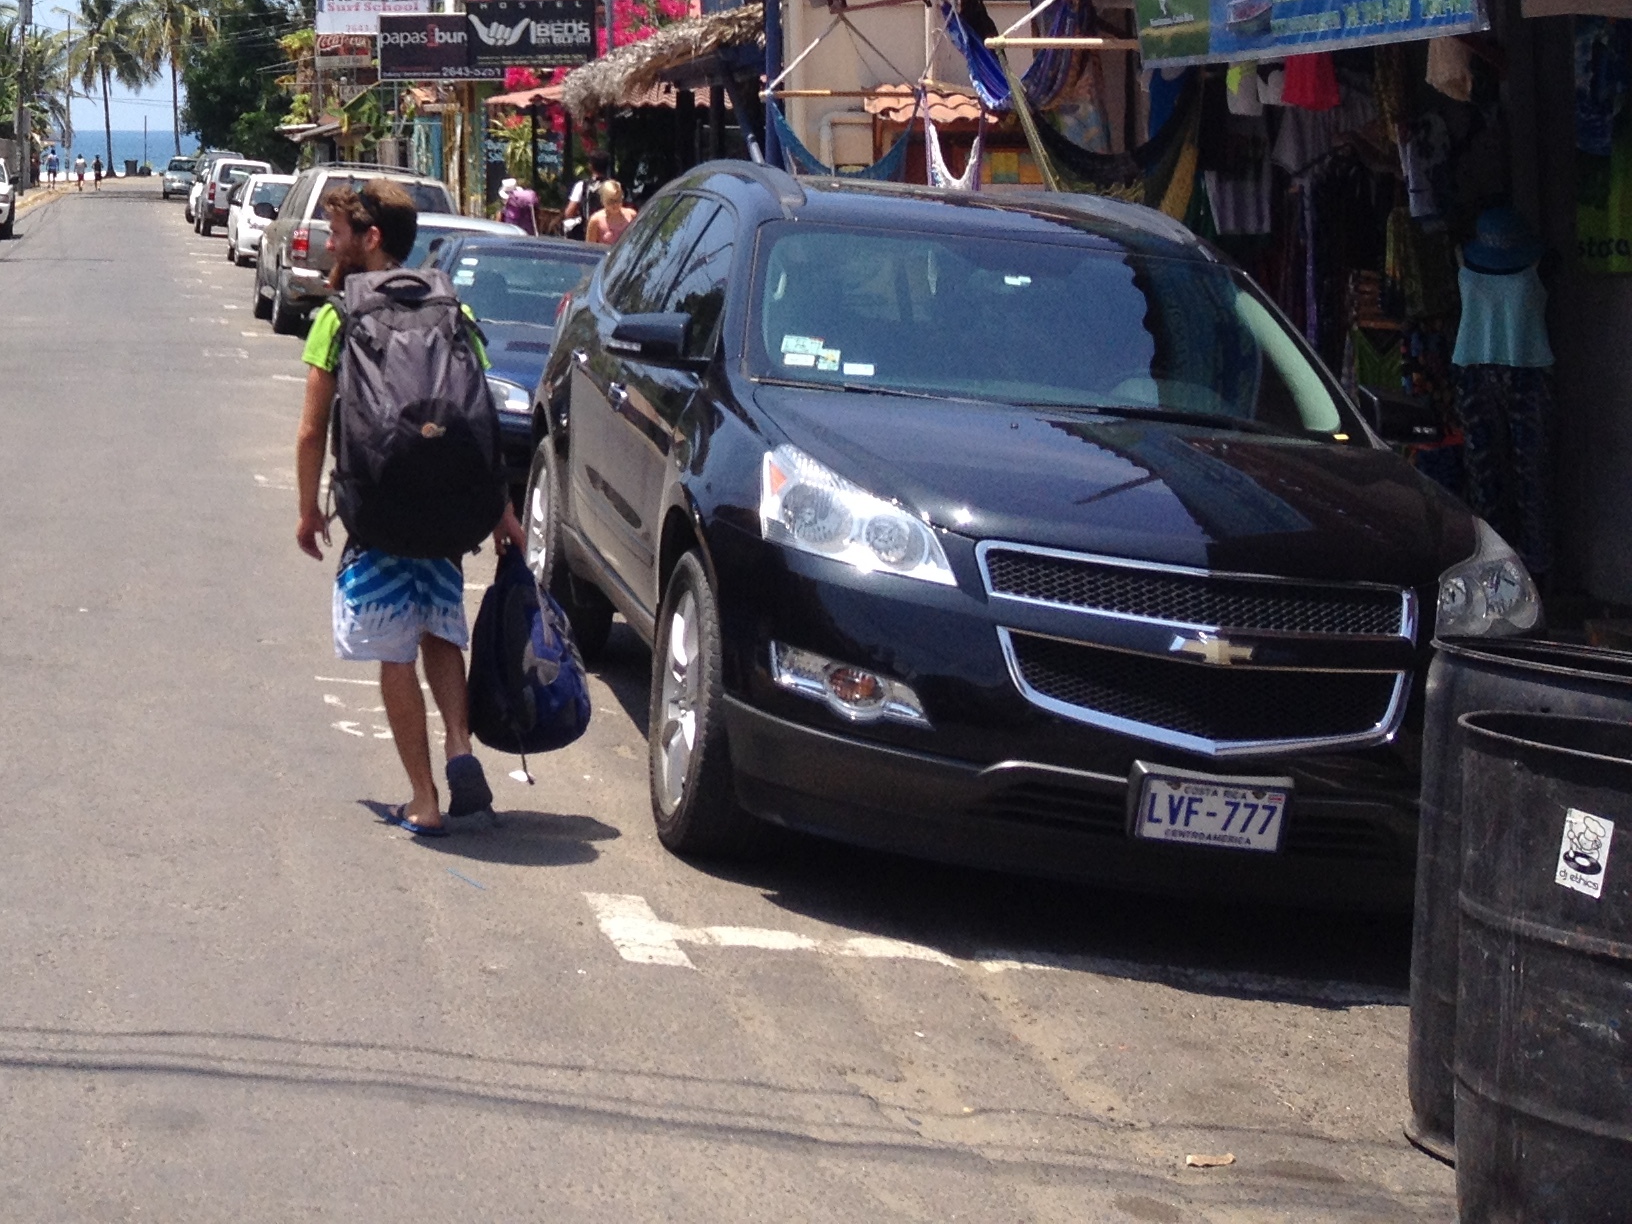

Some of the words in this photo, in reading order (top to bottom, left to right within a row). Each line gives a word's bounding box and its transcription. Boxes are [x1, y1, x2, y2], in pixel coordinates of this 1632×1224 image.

[327, 2, 360, 12] Surf
[364, 2, 418, 12] School
[537, 21, 590, 36] BEDS
[380, 30, 428, 49] papas
[1184, 786, 1218, 797] COSTA
[1223, 790, 1247, 799] RICA
[1147, 792, 1277, 835] LVF-777
[1164, 828, 1251, 845] CENTROAMERICA
[1559, 869, 1568, 880] dj
[1570, 872, 1599, 890] ethics
